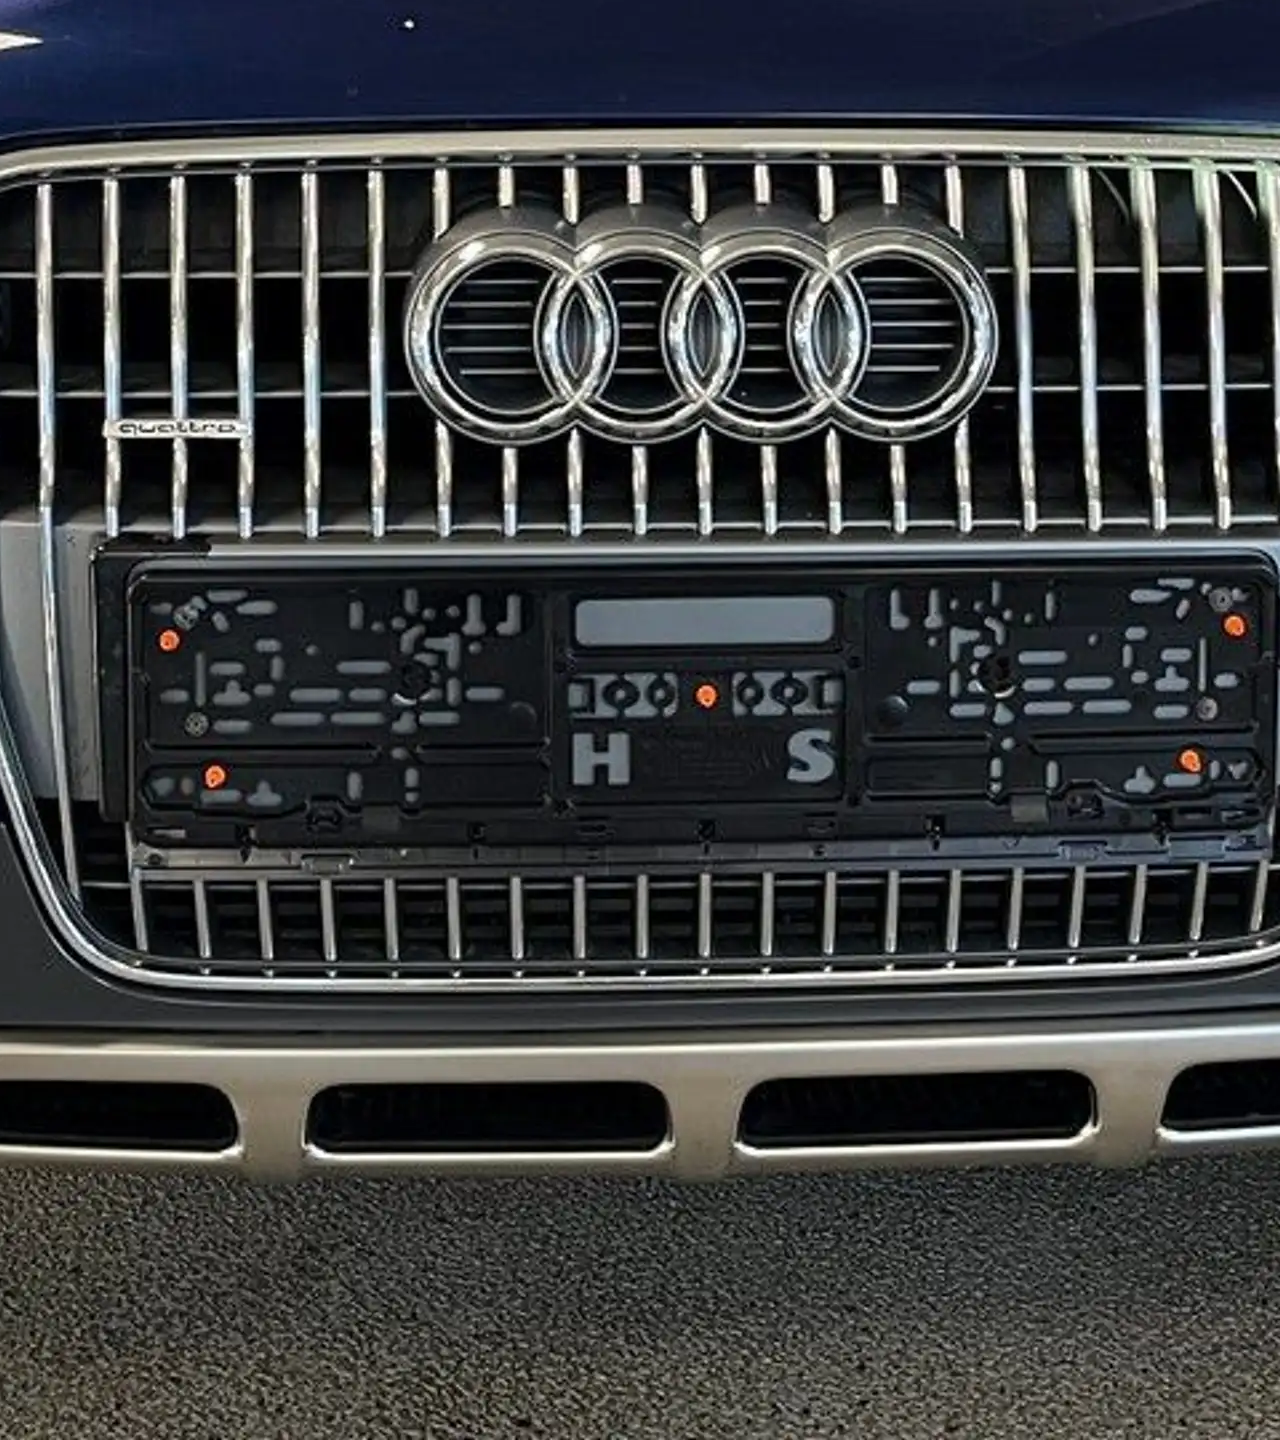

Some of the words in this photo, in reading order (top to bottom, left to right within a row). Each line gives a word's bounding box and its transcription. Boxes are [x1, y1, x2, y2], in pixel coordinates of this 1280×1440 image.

[119, 421, 236, 435] quattro
[572, 732, 630, 786] H
[786, 728, 835, 784] S
